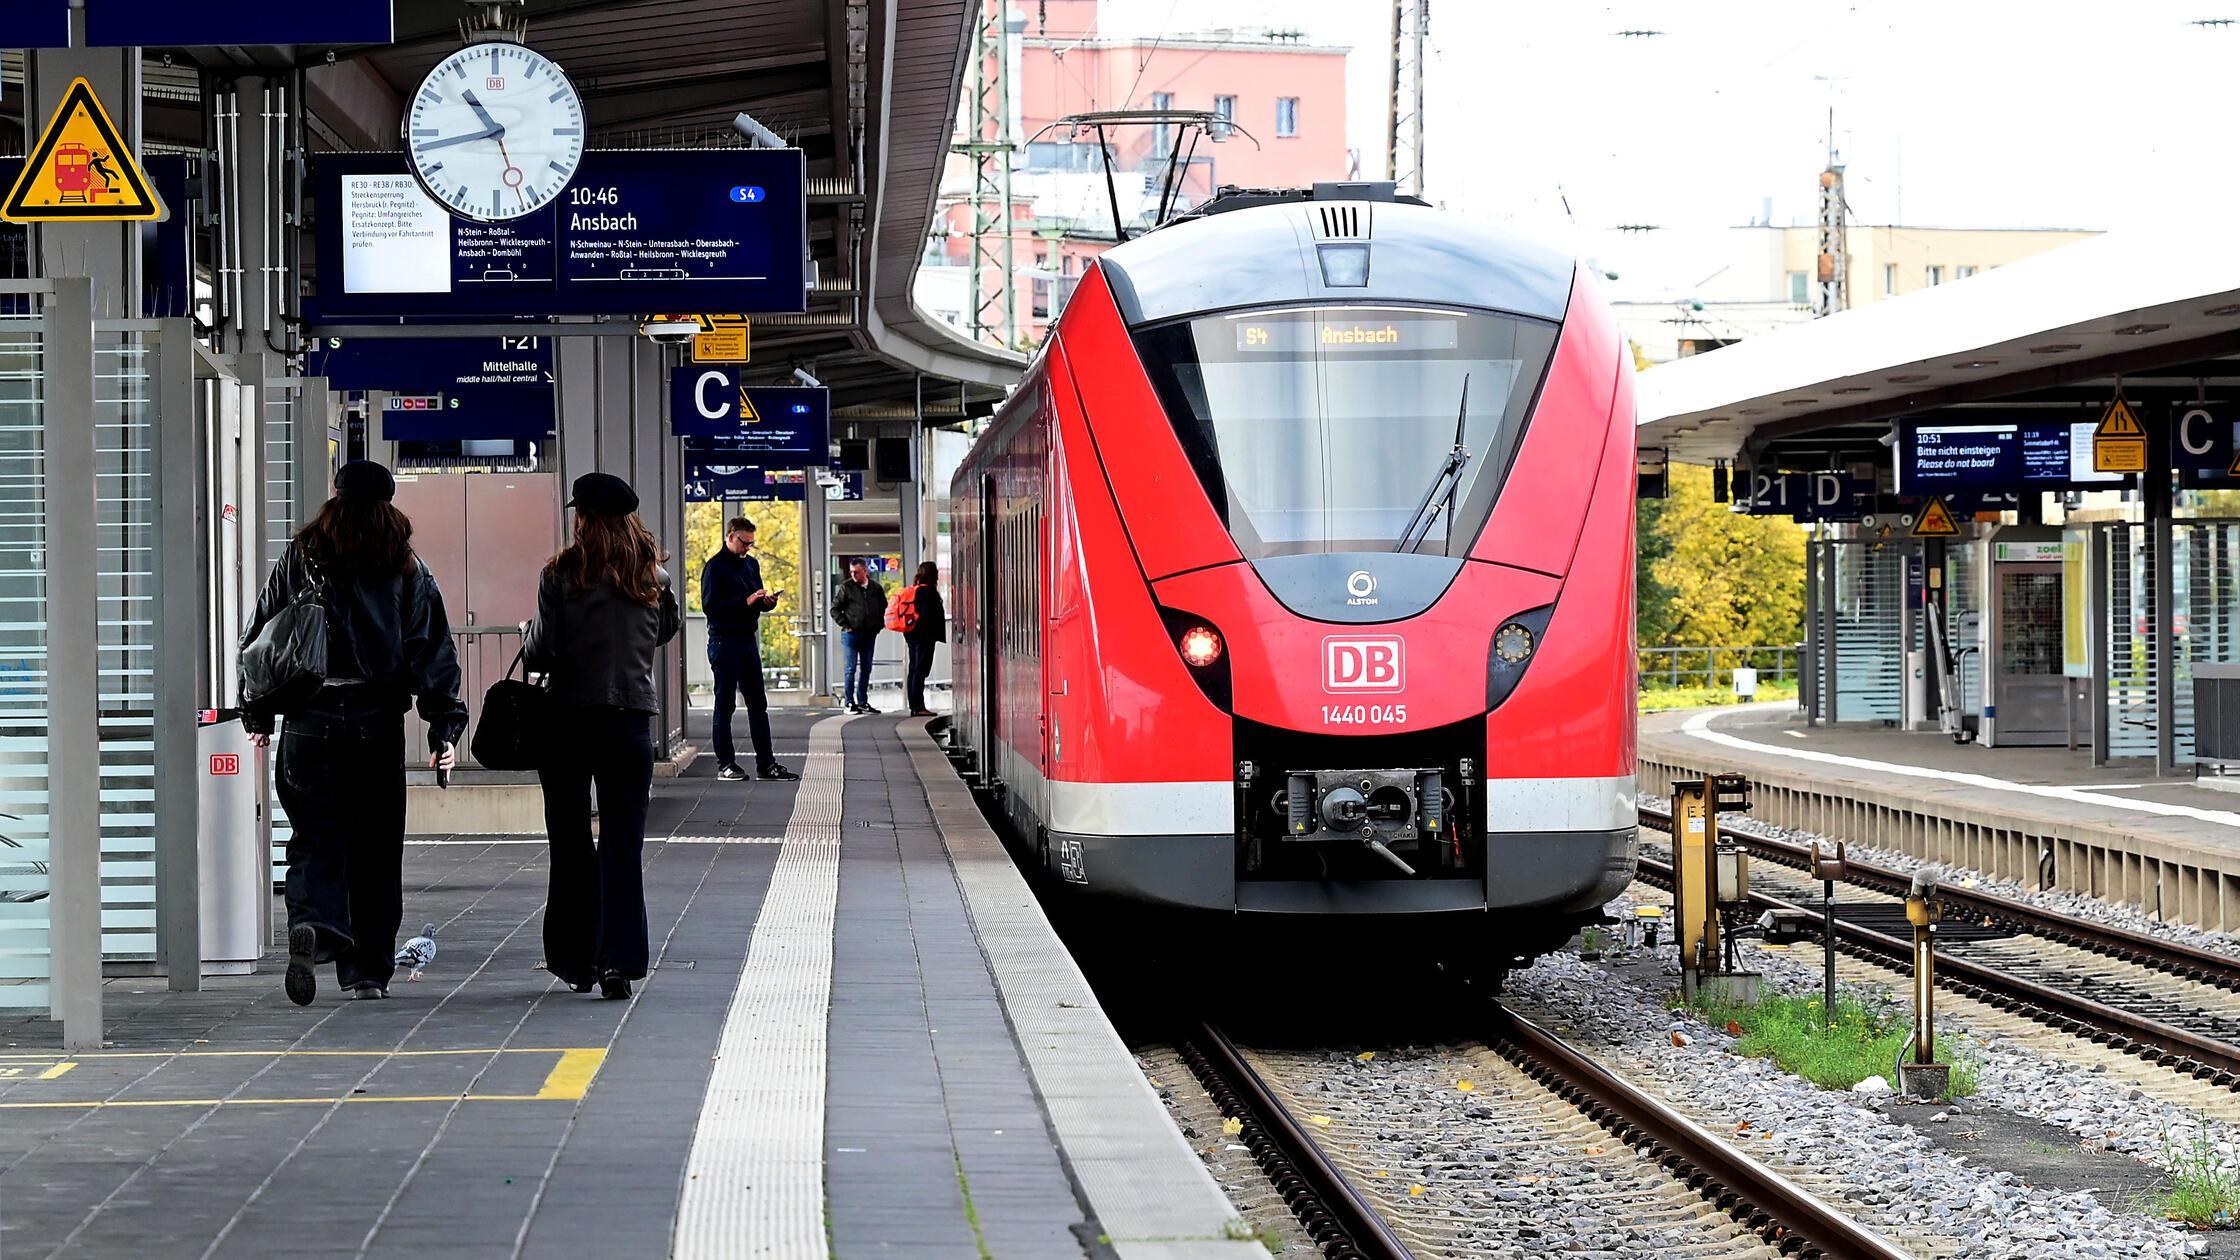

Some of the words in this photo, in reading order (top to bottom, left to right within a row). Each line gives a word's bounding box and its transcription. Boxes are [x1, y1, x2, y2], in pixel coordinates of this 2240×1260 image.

[352, 191, 404, 199] Streckensperrung
[570, 187, 618, 205] 10:46
[739, 188, 756, 201] S4
[390, 201, 415, 209] Pegnitz)
[377, 211, 423, 219] Umfangreiches
[570, 213, 637, 231] Ansbach
[458, 228, 482, 236] N-Stein
[488, 228, 510, 236] Roßtal
[458, 238, 493, 246] Heilsbronn
[500, 238, 546, 247] Wicklesgreuth
[570, 240, 611, 248] N-Schweinau
[649, 240, 689, 248] Unterasbach
[696, 239, 734, 247] Oberasbach
[458, 249, 486, 257] Ansbach
[492, 248, 521, 257] Dombühl
[570, 250, 604, 258] Anwanden
[611, 250, 632, 258] Roßtal
[681, 250, 726, 259] Wicklesgreuth
[1246, 327, 1268, 344] S4
[1322, 326, 1398, 344] Ansbach
[330, 337, 340, 349] S
[483, 361, 537, 372] Mittelhalle
[456, 375, 480, 383] middle
[512, 375, 538, 383] central
[694, 370, 730, 419] C
[392, 399, 400, 408] U
[450, 398, 459, 408] S
[2180, 408, 2214, 455] C
[1917, 434, 1941, 444] 10:51
[1917, 446, 1937, 456] Bitte
[1938, 446, 1958, 455] nicht
[1959, 445, 2001, 456] einsteigen
[1917, 459, 1944, 468] Please
[1944, 459, 1955, 468] do
[1956, 459, 1970, 468] not
[1971, 458, 1995, 468] board
[1757, 475, 1787, 506] 21
[1817, 475, 1841, 506] D
[1332, 644, 1396, 685] DB
[1322, 705, 1366, 724] 1440
[1370, 704, 1407, 724] 045
[213, 756, 237, 773] DB
